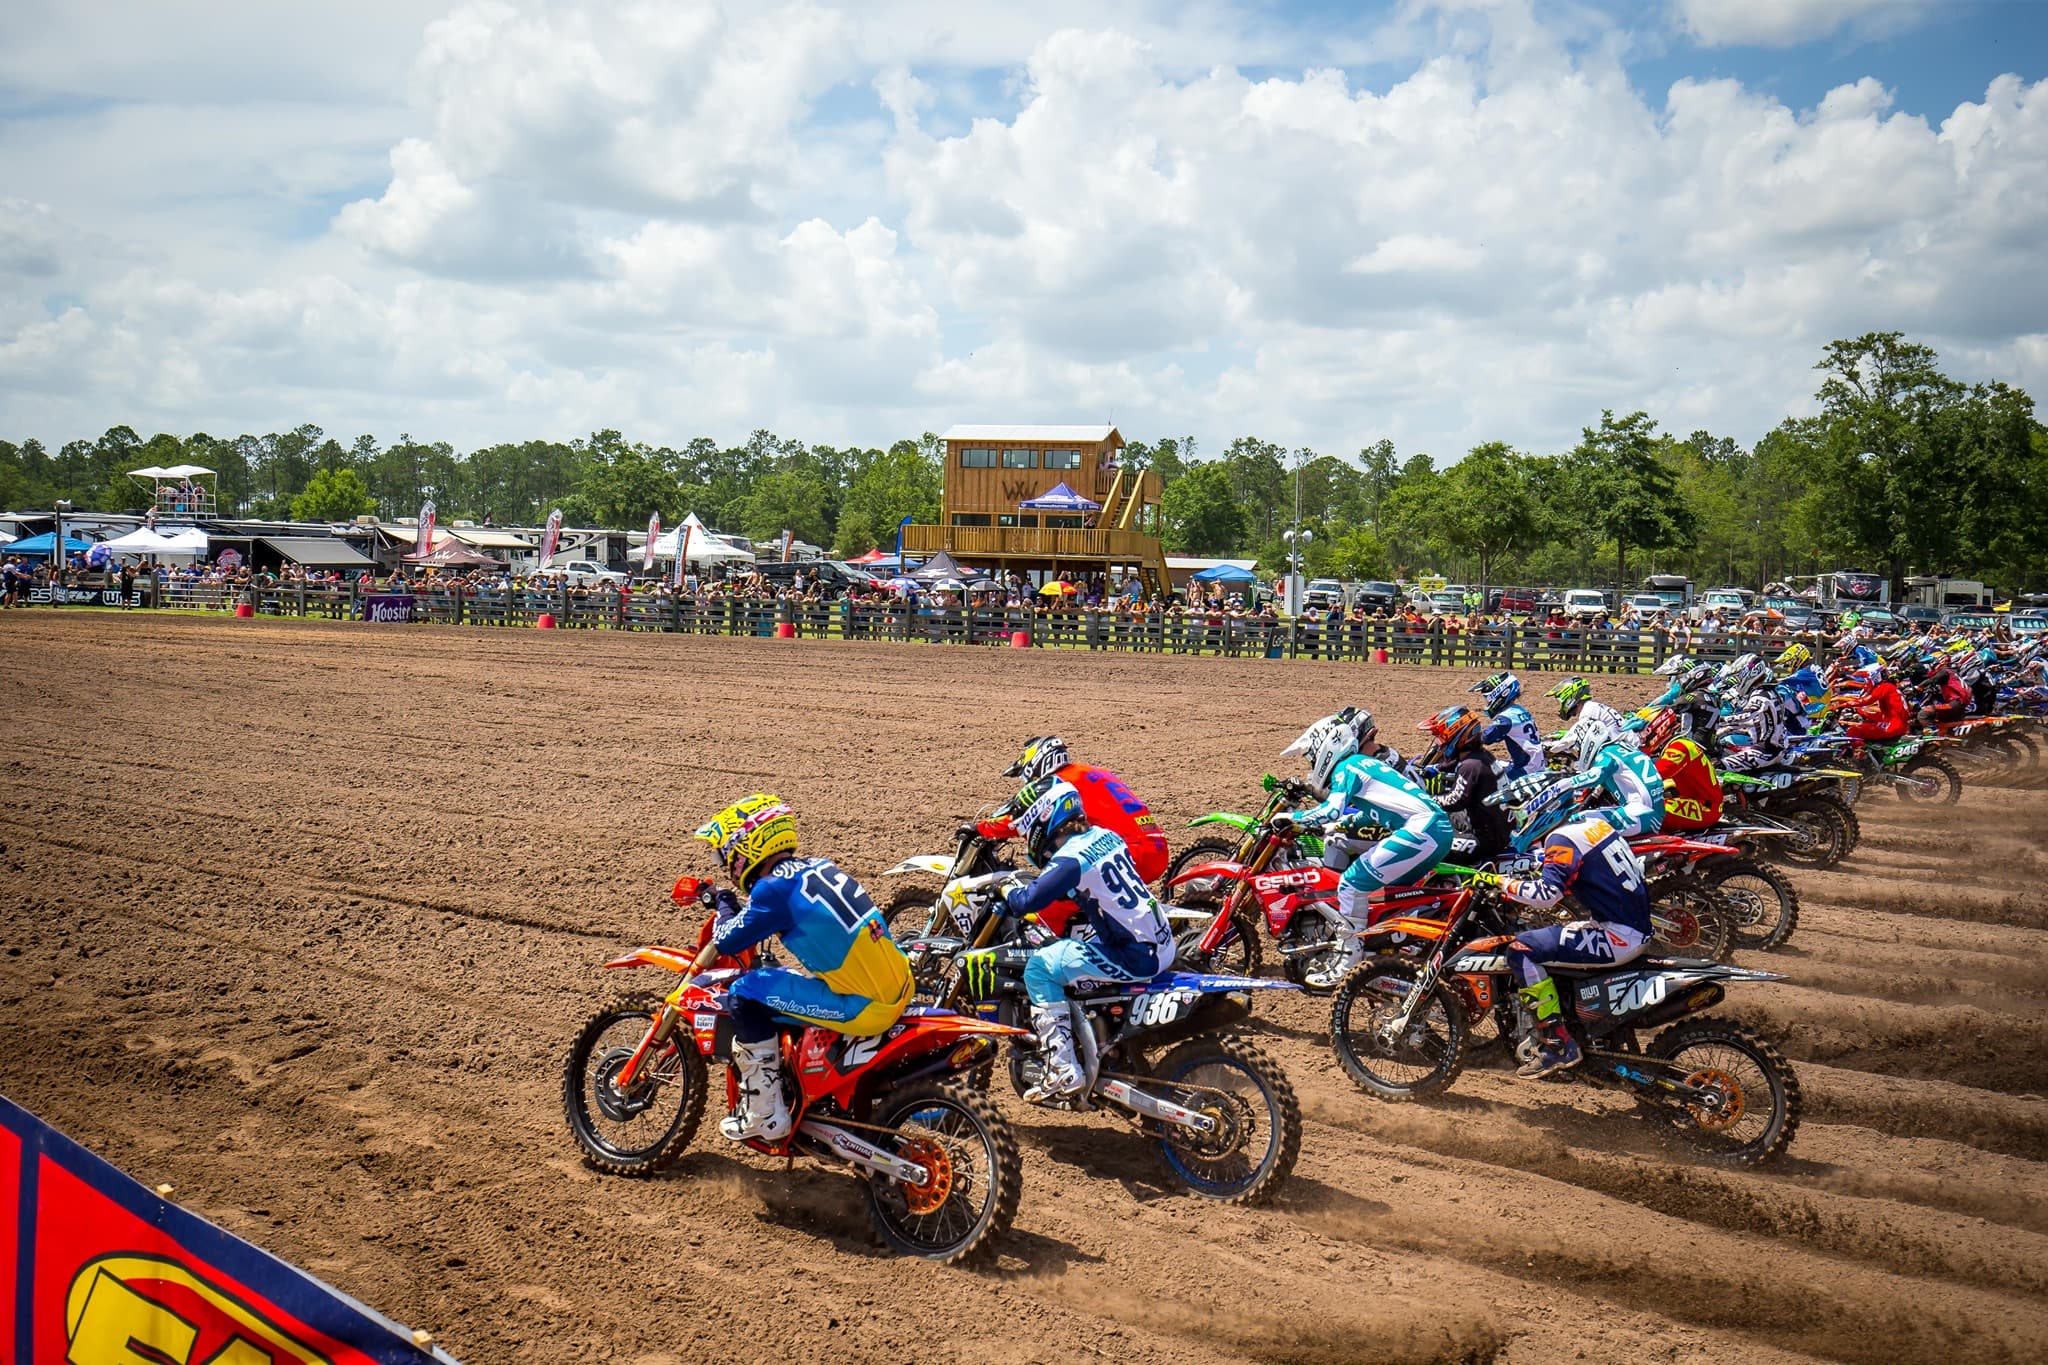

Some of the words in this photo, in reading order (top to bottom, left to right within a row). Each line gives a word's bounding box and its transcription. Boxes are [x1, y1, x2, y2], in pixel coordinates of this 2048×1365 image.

[370, 601, 412, 623] Hoosier
[1895, 744, 1920, 757] 346
[1525, 784, 1562, 815] 100%
[1021, 796, 1052, 830] 100%
[1255, 871, 1321, 890] GEICO
[1519, 878, 1558, 900] FXR
[800, 861, 878, 934] 12
[1394, 889, 1425, 899] HONDA
[1559, 927, 1617, 958] FXR
[1213, 980, 1272, 988] DUNLOP
[766, 996, 786, 1012] Troy
[786, 1000, 806, 1014] Lee
[1607, 975, 1666, 1016] 500
[1129, 992, 1181, 1026] 936
